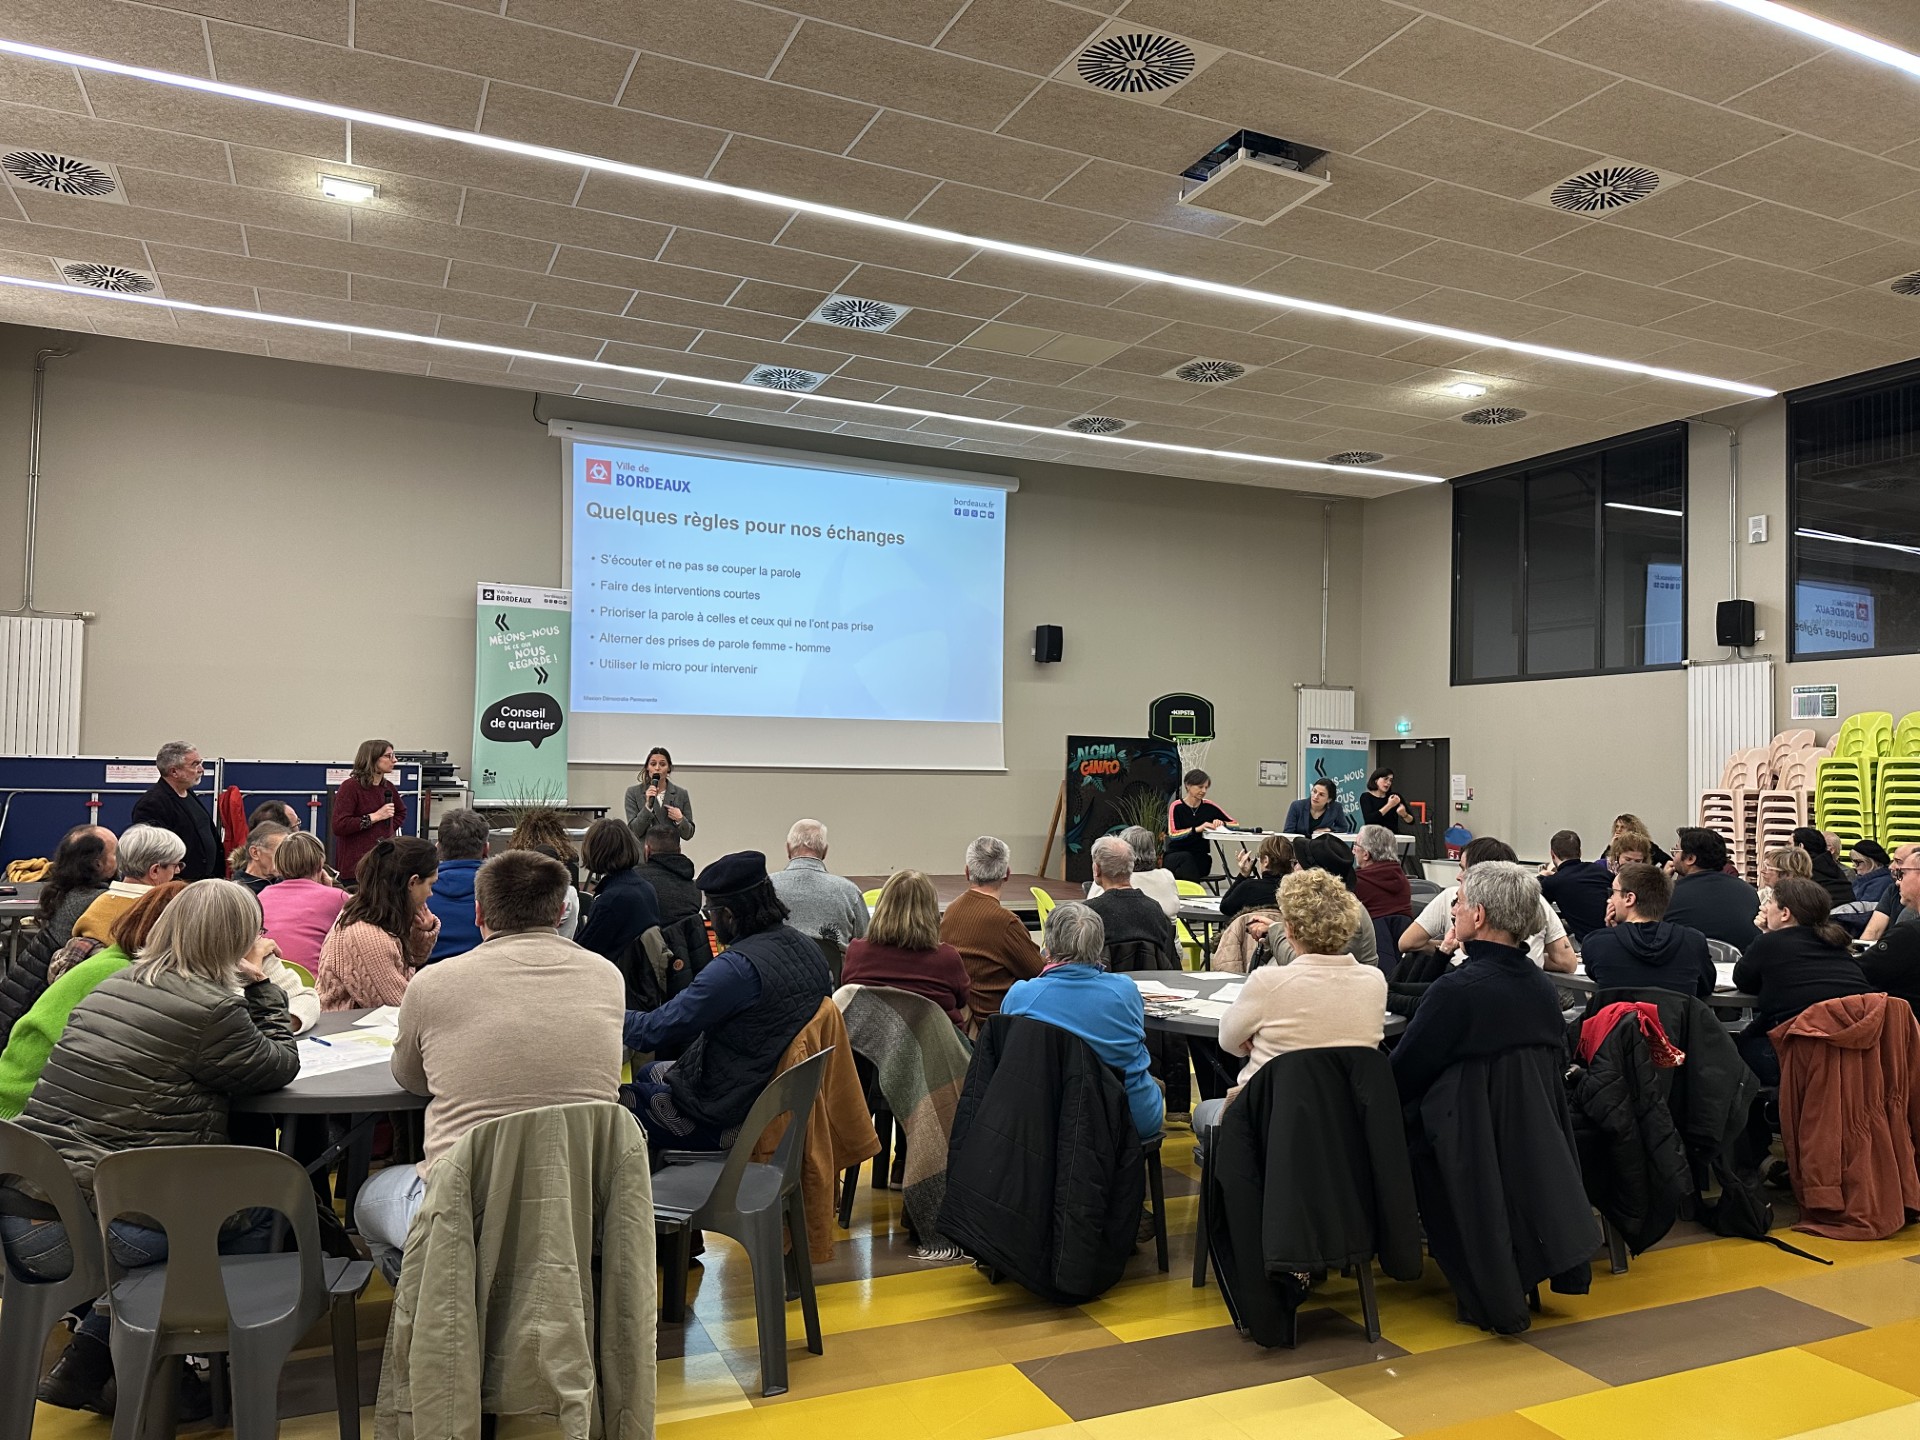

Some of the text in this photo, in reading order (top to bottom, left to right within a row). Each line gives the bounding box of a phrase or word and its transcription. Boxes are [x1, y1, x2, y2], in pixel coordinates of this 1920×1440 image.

[616, 461, 650, 473] Ville de
[616, 473, 691, 493] BORDEAUX
[954, 497, 995, 508] bordeaux.fr
[586, 502, 905, 547] Quelques règles pour nos échanges
[600, 554, 801, 579] S'écouter et ne pas se couper la parole
[600, 580, 761, 600] Faire des interventions courtes
[496, 595, 532, 604] BORDEAUX
[600, 606, 874, 632] Prioriser la parole à celles et ceux qui ne l'ont pas prise
[599, 632, 643, 645] Alterner
[646, 635, 665, 646] des
[668, 636, 700, 648] prises
[702, 638, 716, 648] de
[718, 639, 750, 650] parole
[752, 640, 786, 651] femme
[795, 642, 831, 653] homme
[514, 645, 546, 660] NOUS
[508, 655, 552, 672] REGARDE
[599, 658, 758, 674] Utiliser le micro pour intervenir
[501, 706, 546, 718] Conseil
[490, 718, 556, 731] de quartier
[1077, 743, 1117, 759] ALOHA
[1335, 791, 1355, 803] OUS
